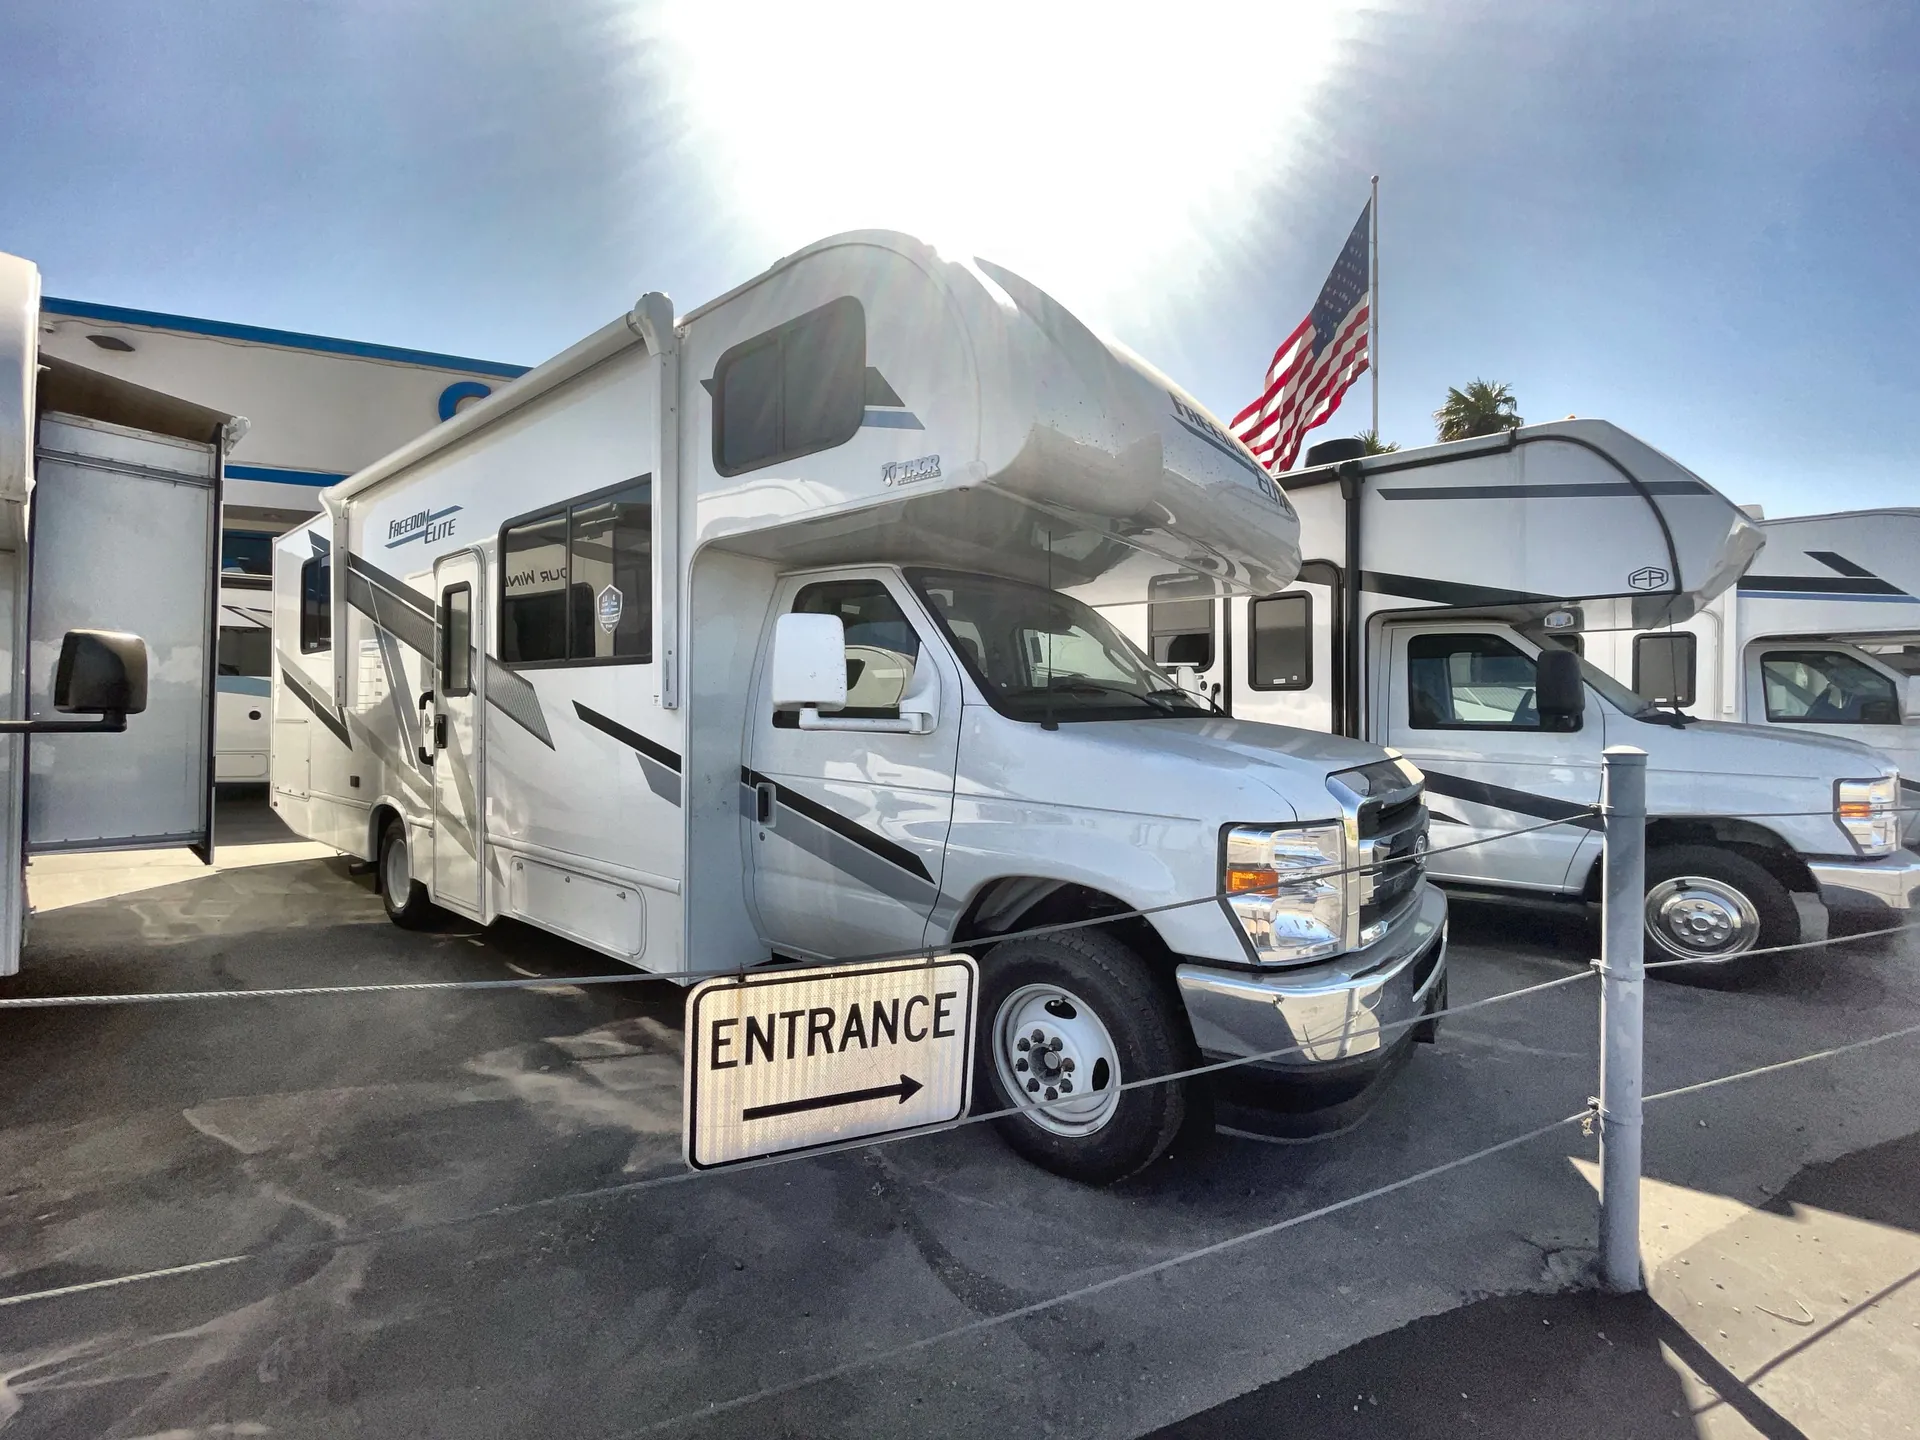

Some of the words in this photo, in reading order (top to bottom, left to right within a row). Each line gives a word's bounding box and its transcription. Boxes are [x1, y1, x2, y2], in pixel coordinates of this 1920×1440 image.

[897, 454, 940, 479] THOR
[388, 508, 430, 540] FREEDOM
[424, 518, 456, 544] ELITE
[711, 991, 957, 1070] ENTRANCE
